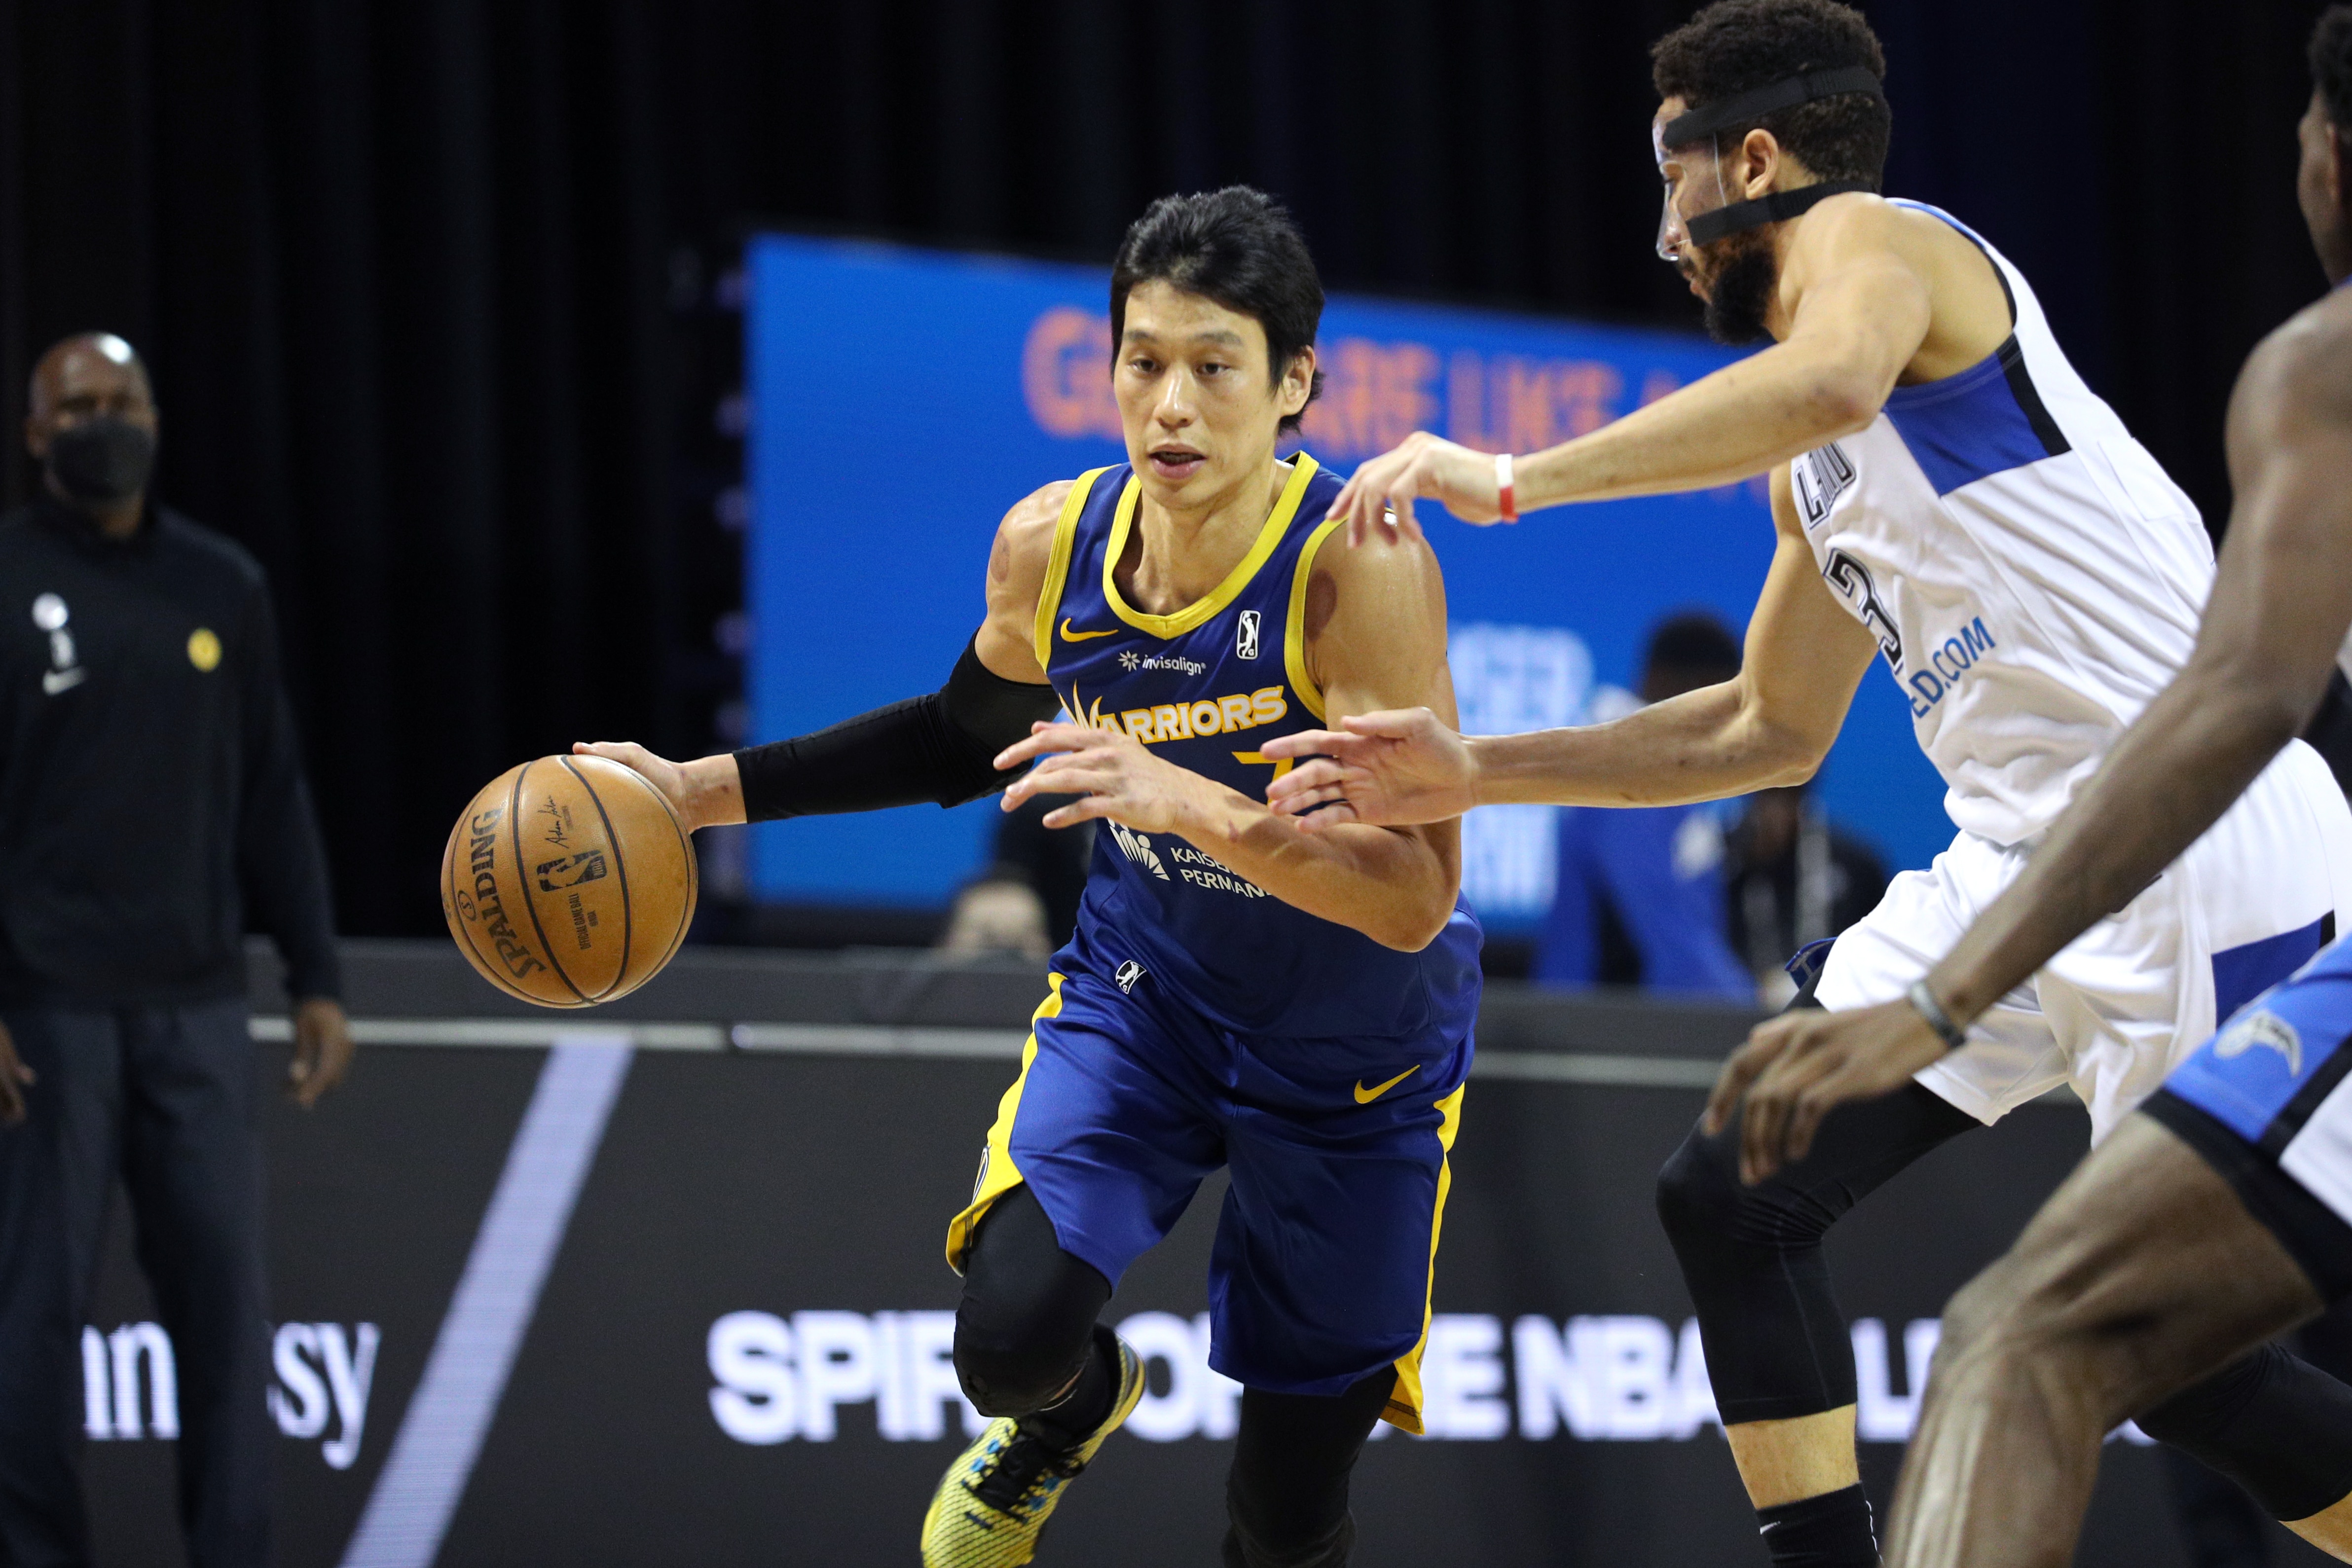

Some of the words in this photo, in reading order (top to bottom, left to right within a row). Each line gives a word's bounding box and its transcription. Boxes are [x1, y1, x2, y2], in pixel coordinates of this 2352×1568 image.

[1058, 679, 1288, 744] WARRIORS
[1167, 847, 1237, 875] KAISE
[471, 809, 547, 979] SPALDING
[1179, 869, 1272, 899] PERMAN
[568, 893, 582, 909] BALL
[572, 908, 586, 925] GAME
[576, 925, 591, 950] OFFICIAL
[706, 1310, 992, 1445] SPIR
[1510, 1313, 1727, 1443] NBA
